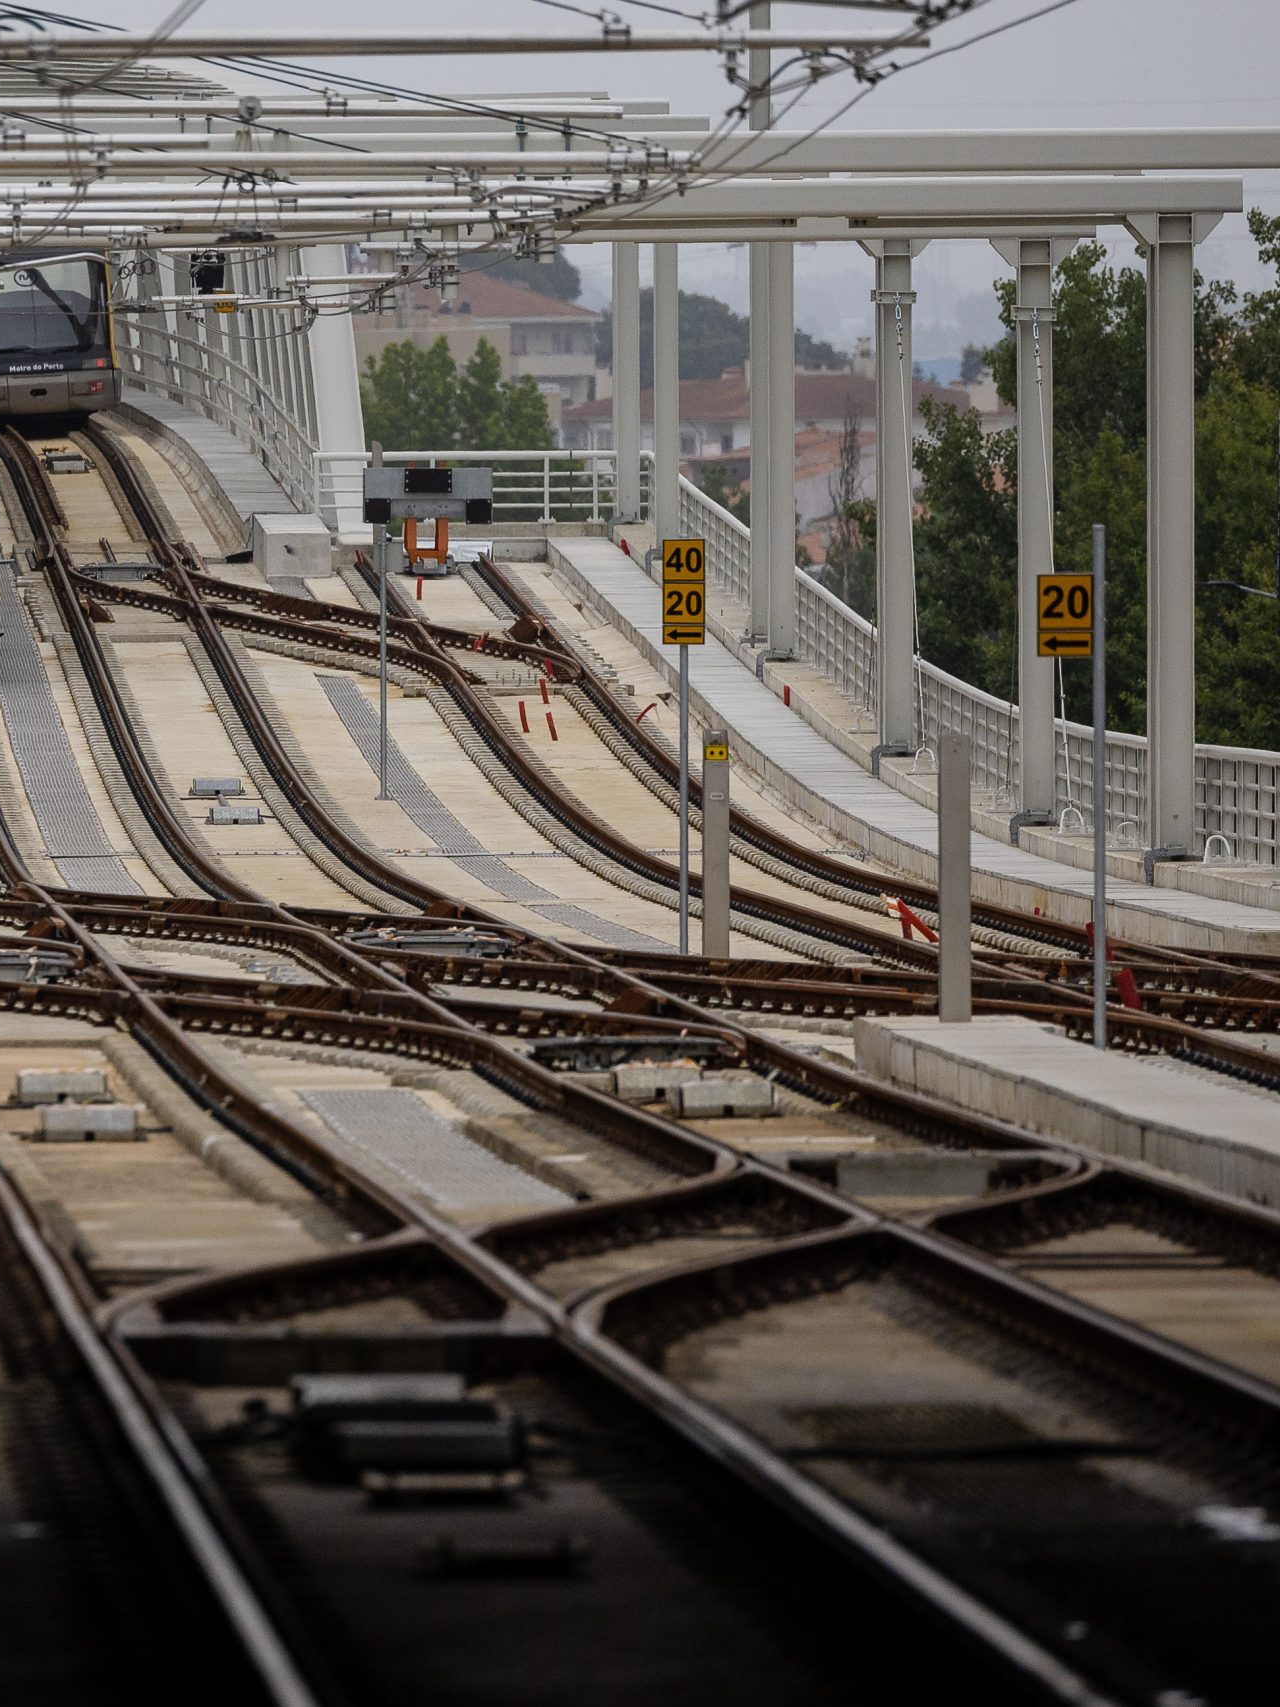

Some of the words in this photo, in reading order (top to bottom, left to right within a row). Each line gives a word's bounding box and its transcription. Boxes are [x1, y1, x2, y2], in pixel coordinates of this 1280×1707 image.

[666, 547, 702, 573] 40
[666, 591, 702, 616] 20
[1042, 585, 1089, 619] 20
